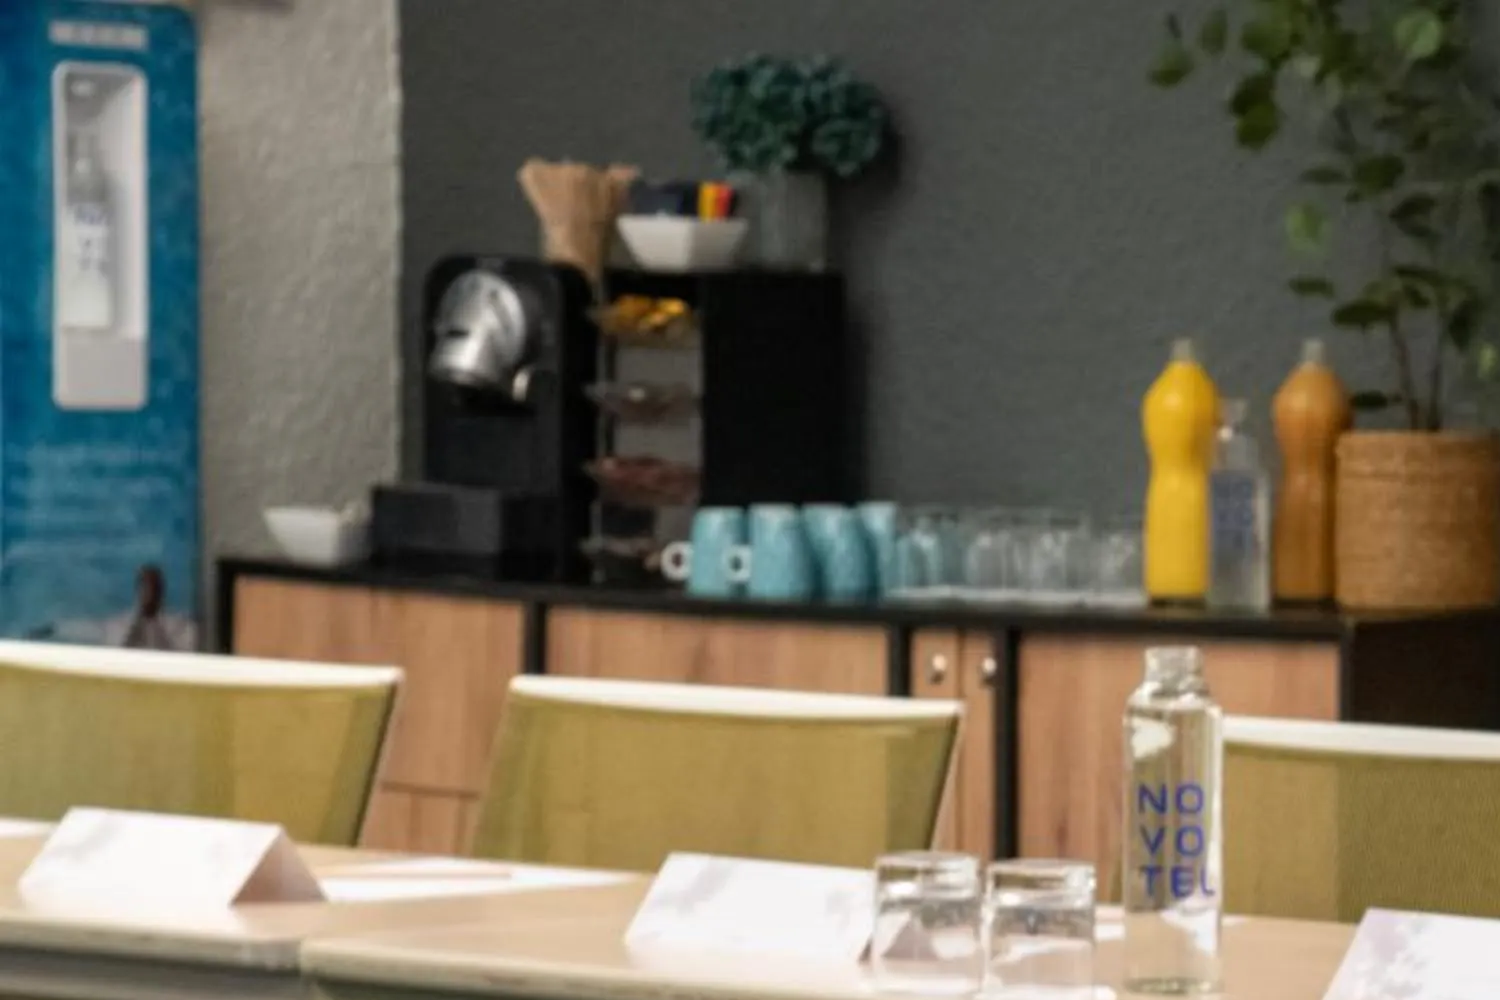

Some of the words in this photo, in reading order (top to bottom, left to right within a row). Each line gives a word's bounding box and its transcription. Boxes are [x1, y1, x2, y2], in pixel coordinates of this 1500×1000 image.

[1138, 784, 1204, 815] NO
[1139, 825, 1204, 857] VO
[1139, 865, 1216, 898] TEL
